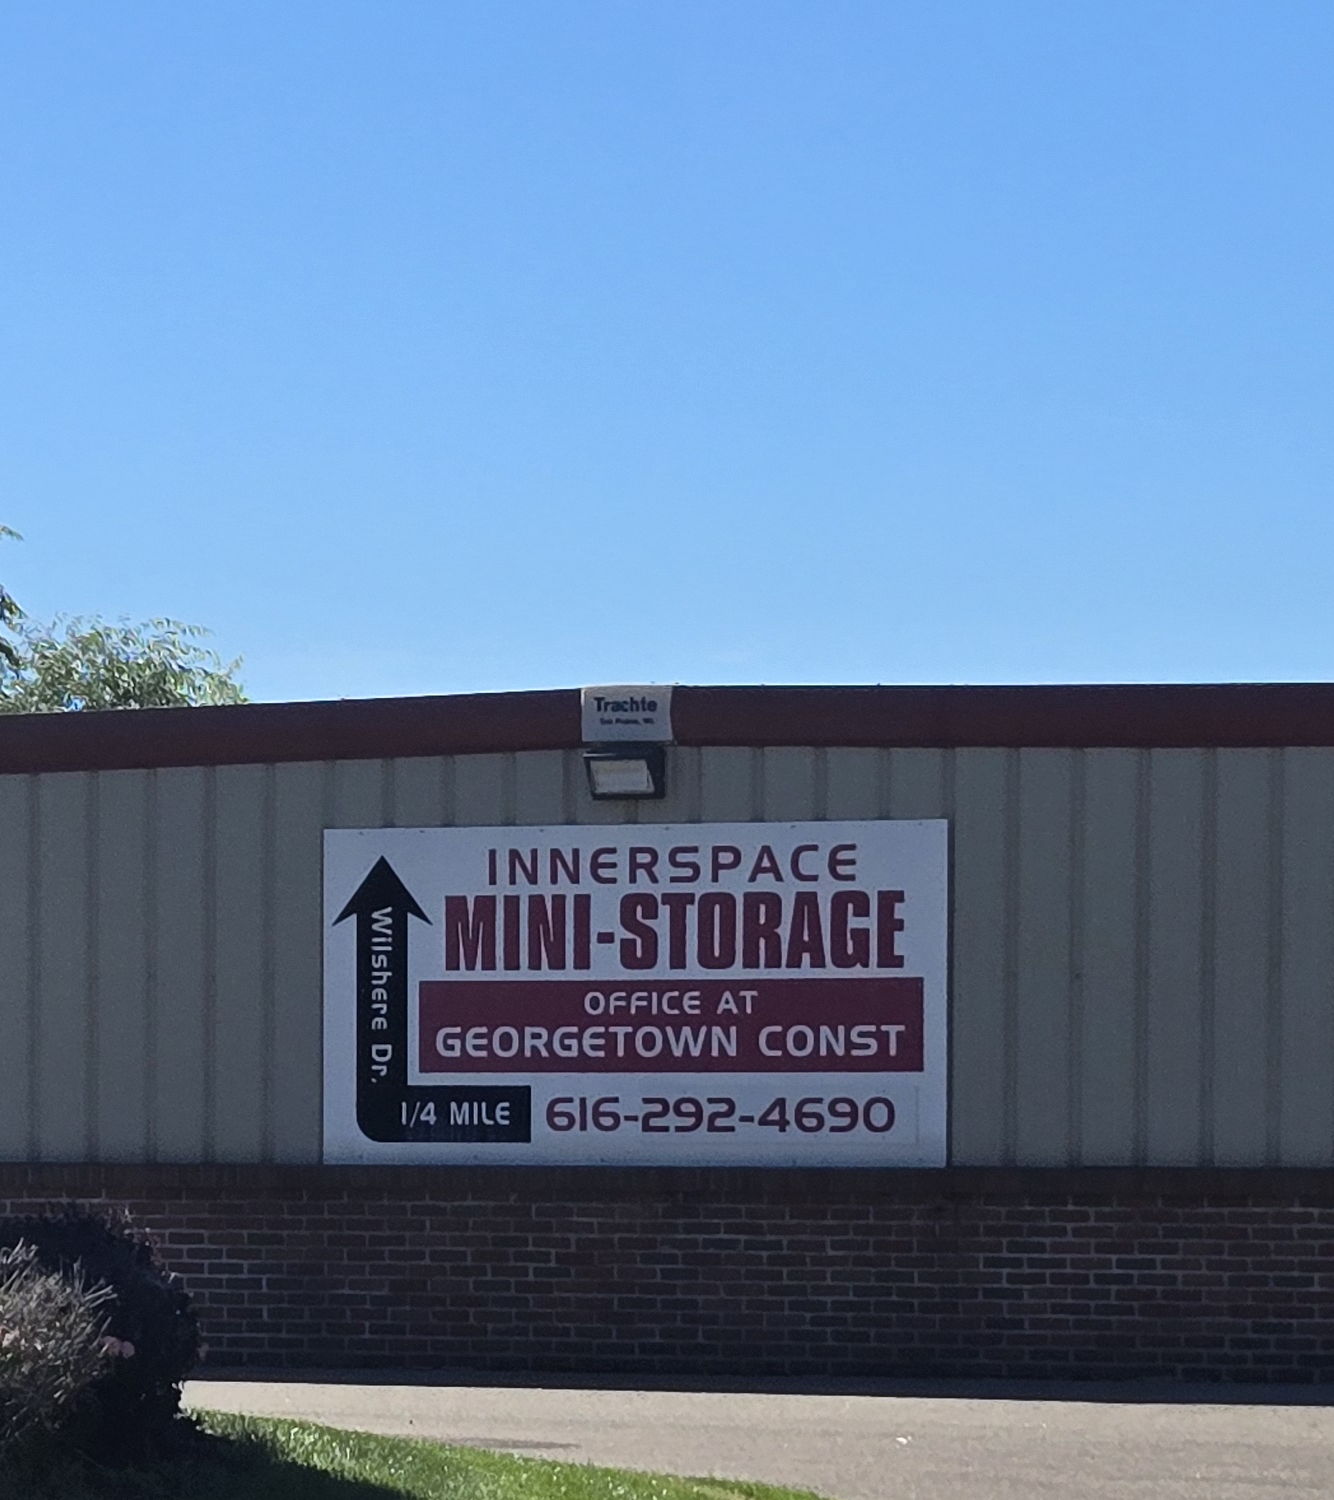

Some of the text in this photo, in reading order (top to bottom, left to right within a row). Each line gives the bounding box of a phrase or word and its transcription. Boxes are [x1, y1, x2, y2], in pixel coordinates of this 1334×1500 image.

[593, 696, 658, 713] Trachte
[488, 844, 857, 886] INNERSPACE
[444, 891, 905, 971] MINI-STORAGE
[370, 906, 393, 1083] Wilshere Dr.
[583, 990, 758, 1015] OFFICE AT
[435, 1025, 905, 1058] GEORGETOWN CONST
[400, 1102, 510, 1126] 1/4 MILE
[545, 1097, 895, 1132] 616-292-4690
